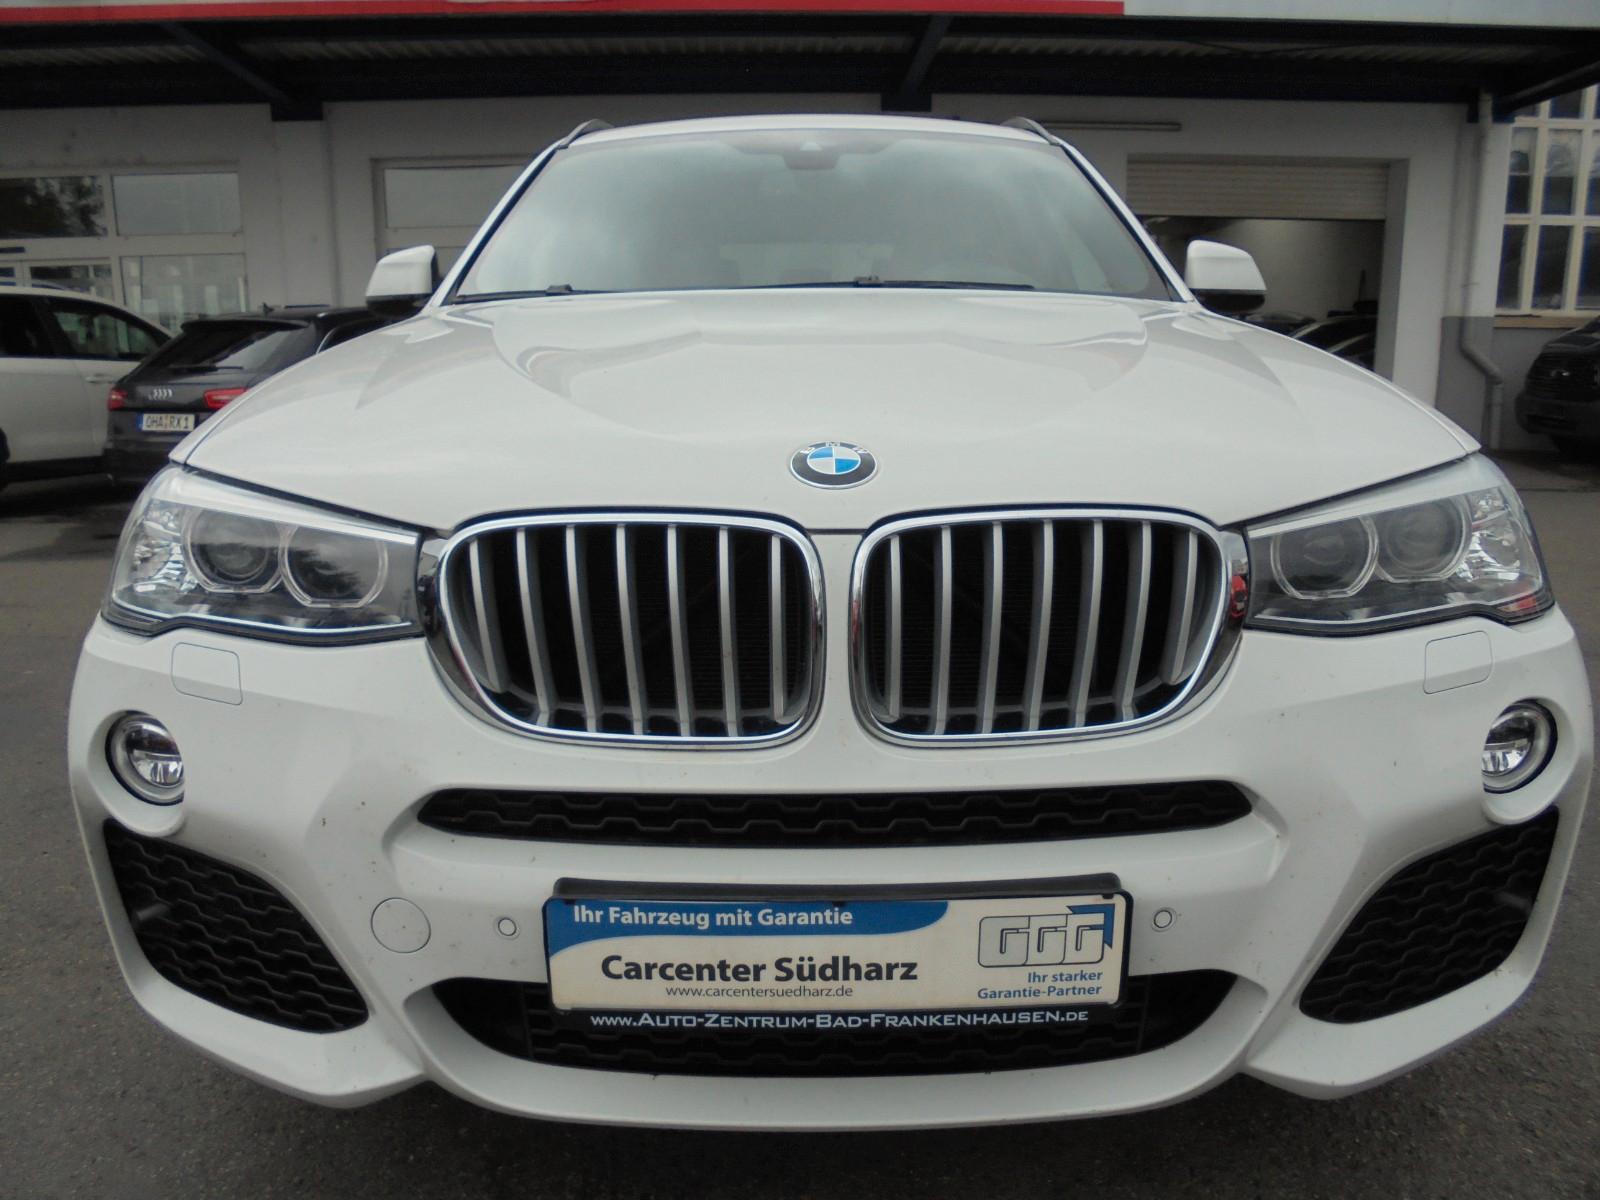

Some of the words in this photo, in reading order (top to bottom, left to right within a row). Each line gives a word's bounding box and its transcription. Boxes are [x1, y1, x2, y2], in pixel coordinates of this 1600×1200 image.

[574, 905, 600, 923] Ihr
[609, 907, 709, 930] Fahrzeug
[716, 908, 752, 925] mit
[758, 907, 853, 925] Garantie
[601, 955, 767, 981] Carcenter
[774, 956, 918, 981] Südharz
[1027, 971, 1048, 983] Ihr
[1052, 970, 1103, 982] starker
[666, 985, 853, 998] www.carcentersuedharz.de
[977, 985, 1103, 1000] Garantie-Partner
